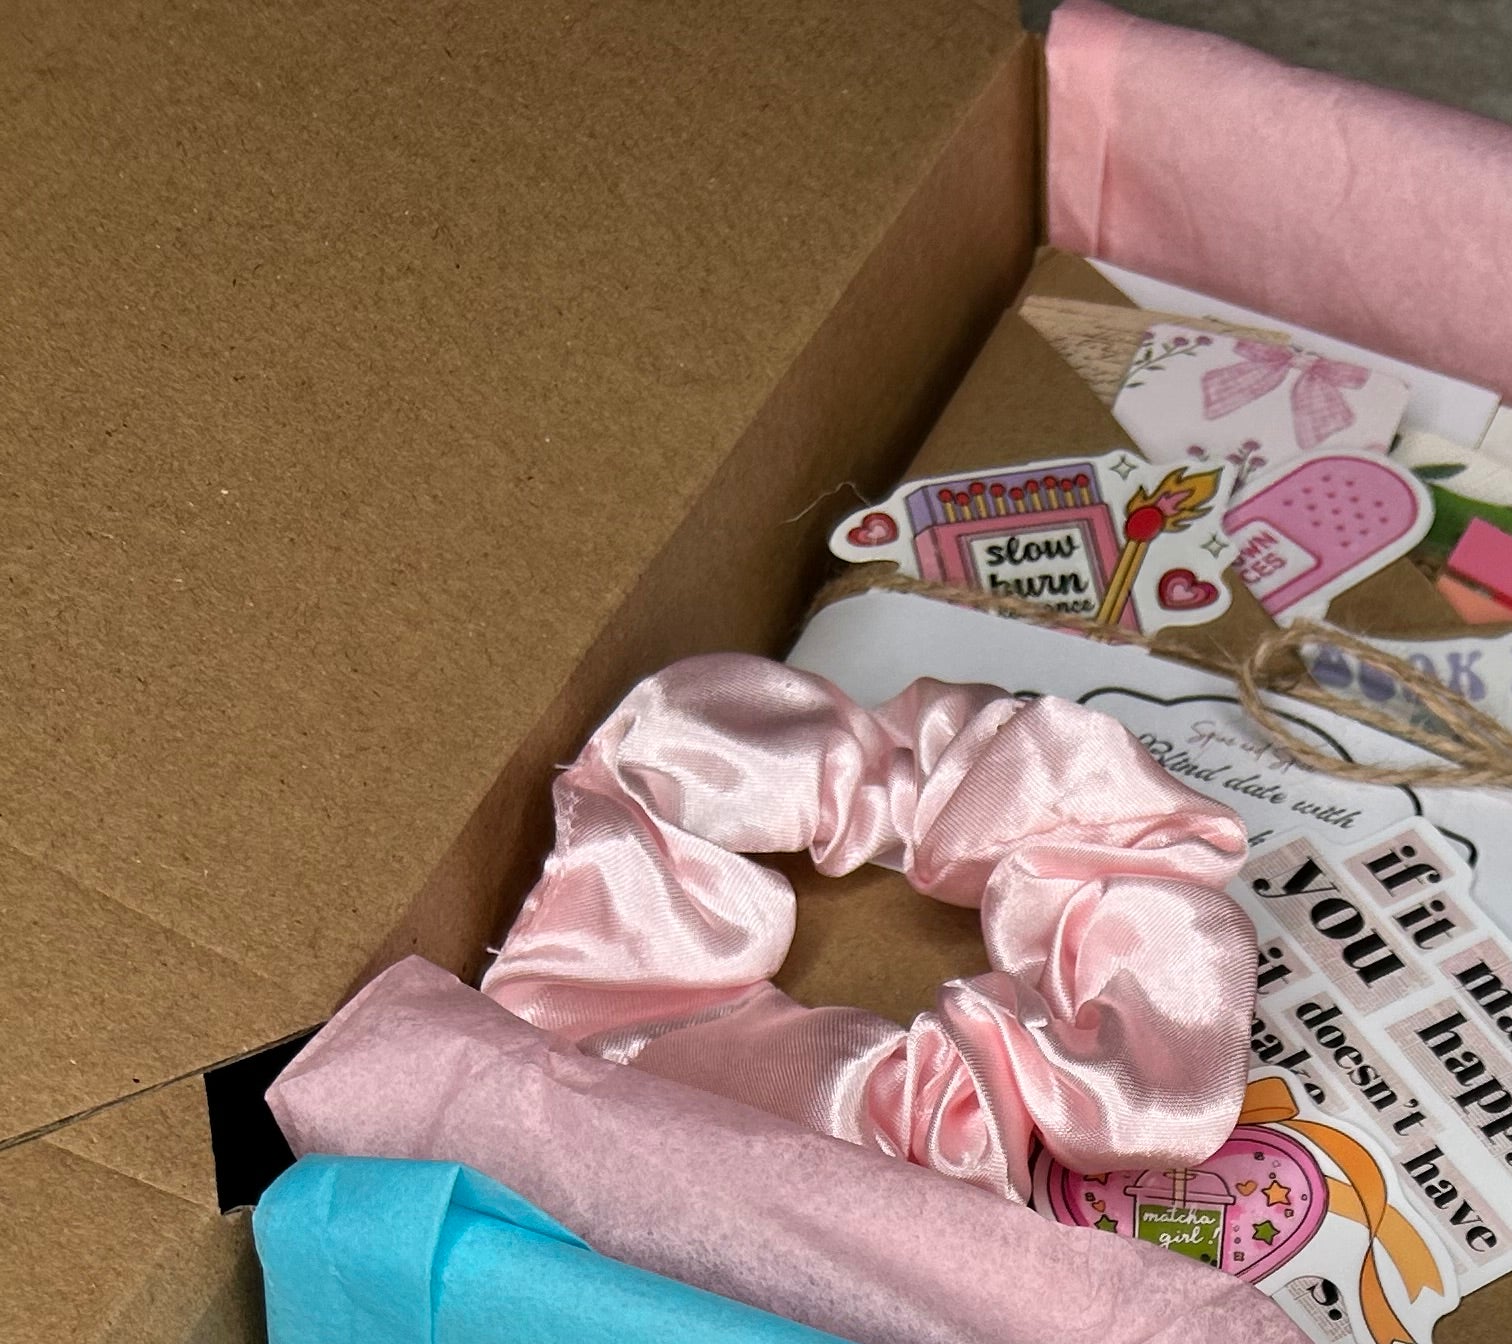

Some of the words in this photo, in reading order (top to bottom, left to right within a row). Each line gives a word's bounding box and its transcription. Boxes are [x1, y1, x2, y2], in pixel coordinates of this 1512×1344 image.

[985, 535, 1080, 567] slow
[1138, 731, 1224, 783] Blind
[1221, 765, 1290, 804] date
[1291, 800, 1364, 829] with
[1364, 844, 1444, 898] if
[1251, 856, 1406, 990] you
[1391, 899, 1458, 952] it
[1295, 1000, 1428, 1138] doesn't
[1400, 1145, 1498, 1253] have
[1143, 1206, 1217, 1226] matcha
